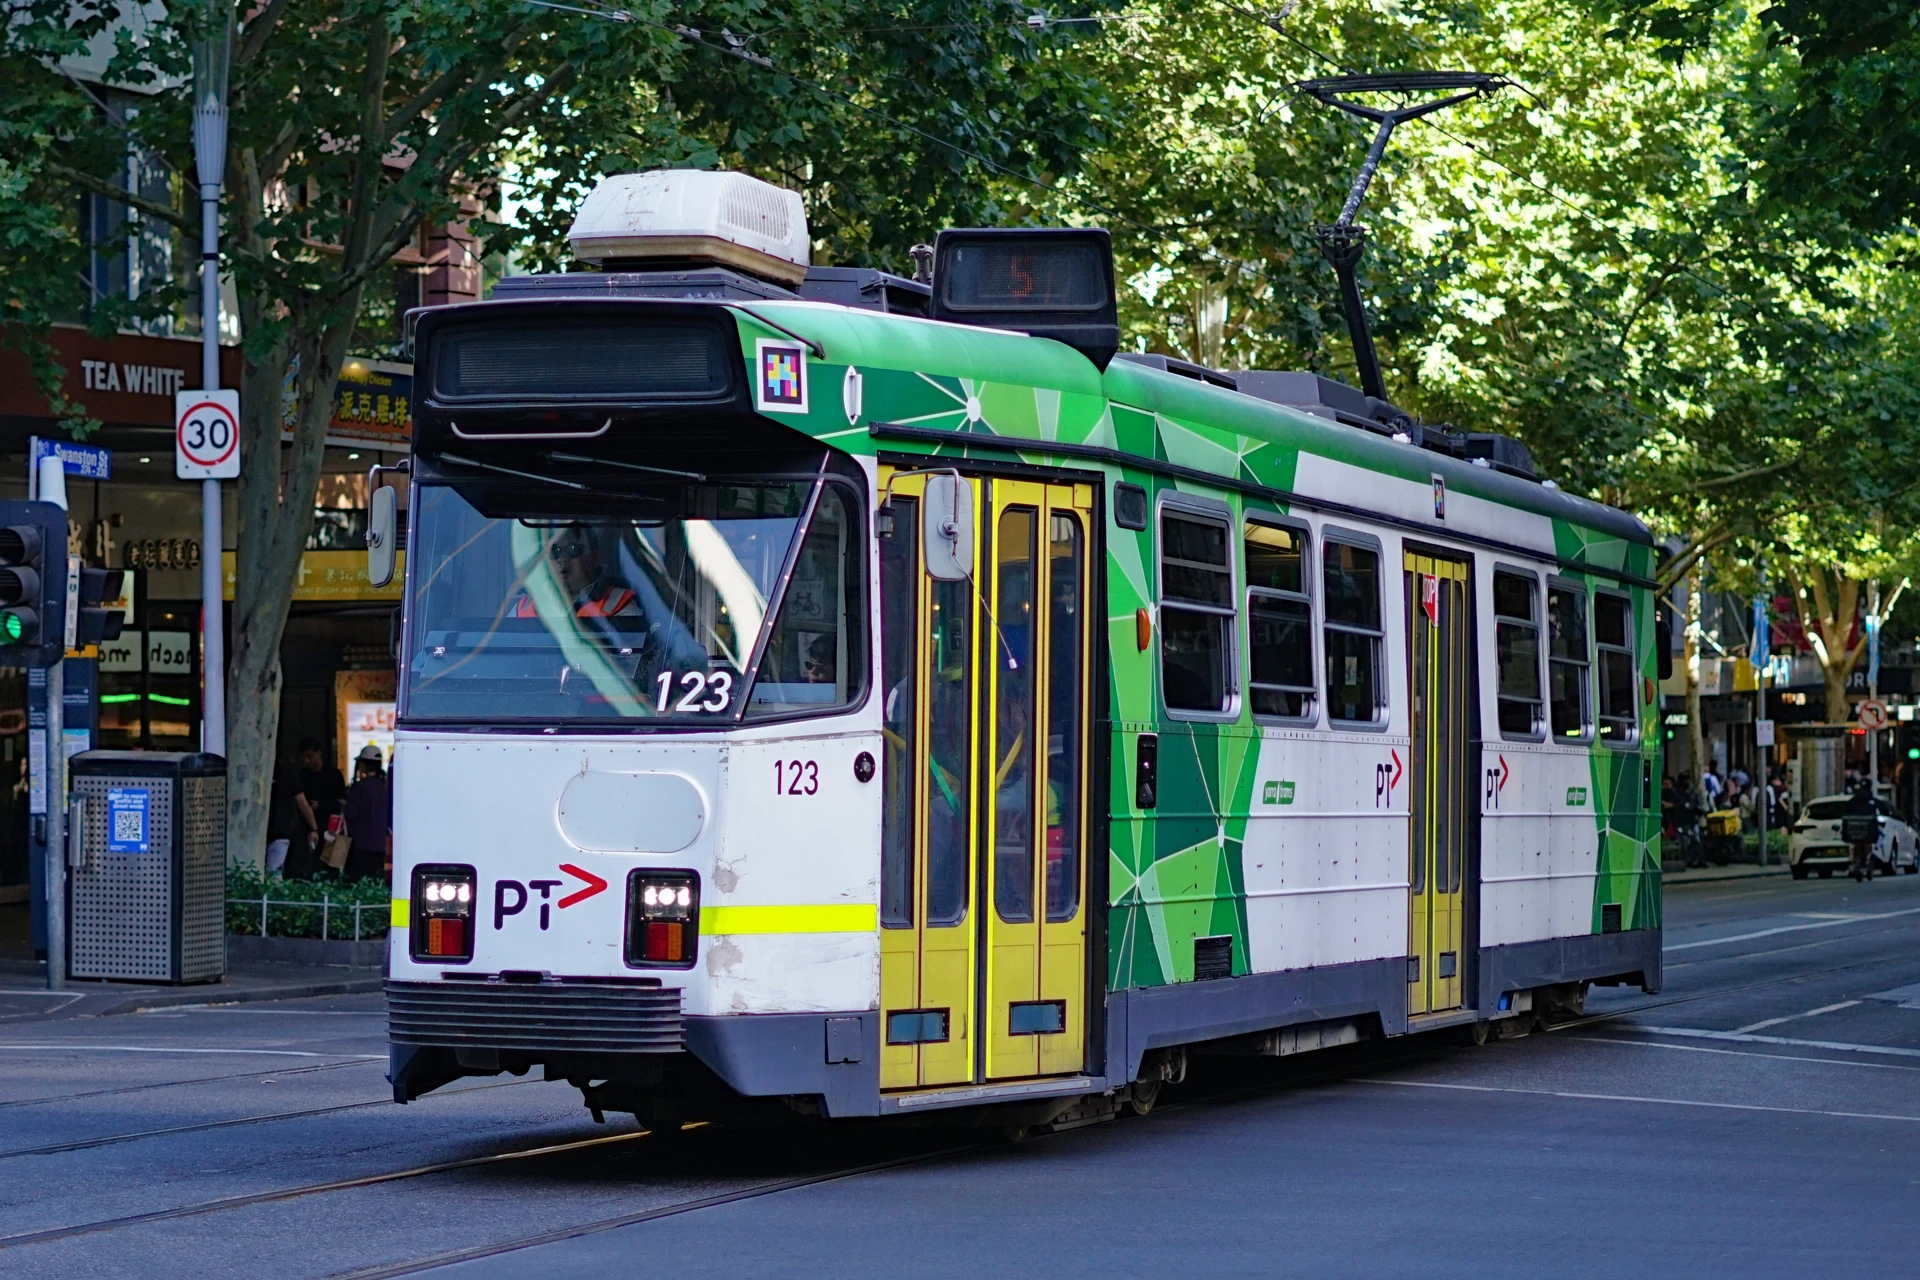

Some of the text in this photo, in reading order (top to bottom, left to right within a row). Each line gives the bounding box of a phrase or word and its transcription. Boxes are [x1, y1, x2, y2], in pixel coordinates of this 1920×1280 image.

[81, 360, 185, 396] TEA WHITE
[188, 419, 229, 449] 30
[55, 443, 109, 468] Swanston St
[657, 671, 732, 712] 123
[1664, 713, 1688, 725] ANZ
[774, 759, 819, 795] 123
